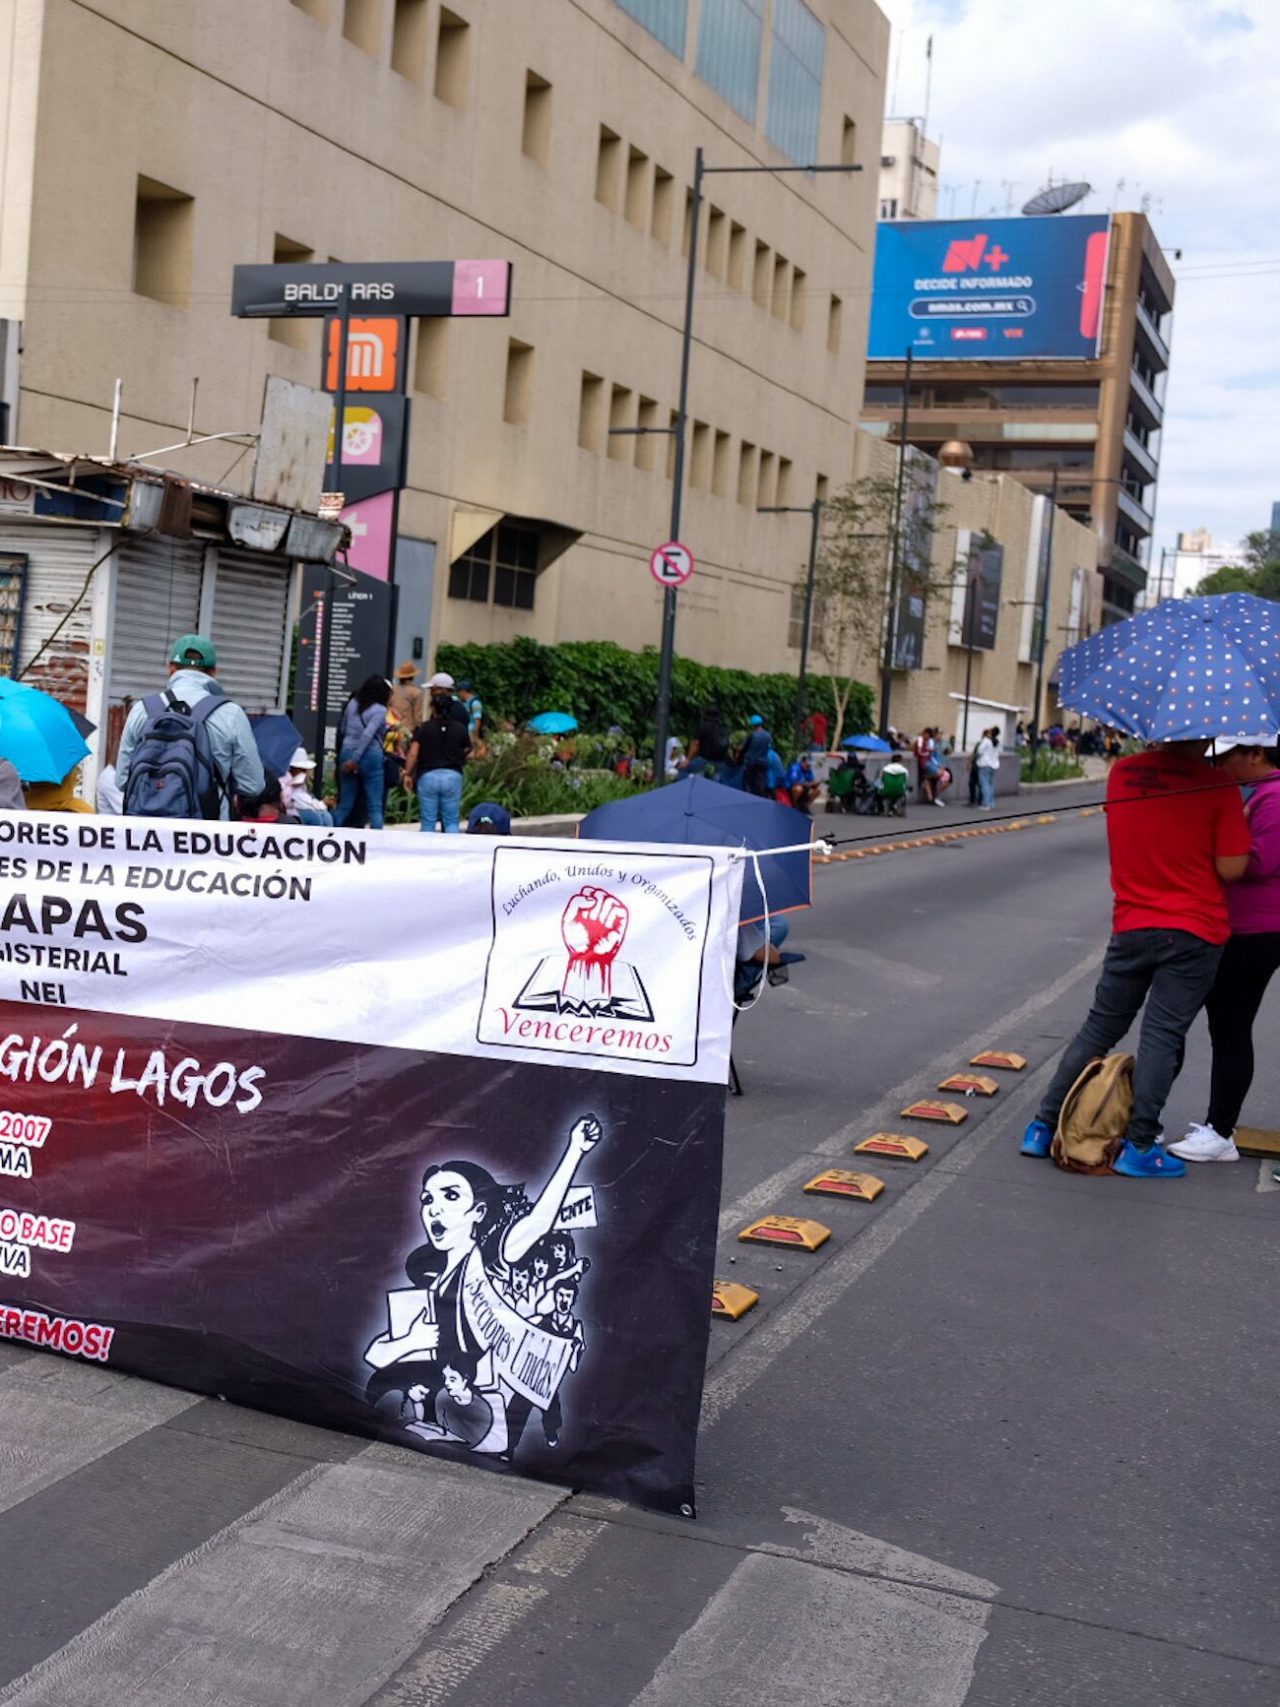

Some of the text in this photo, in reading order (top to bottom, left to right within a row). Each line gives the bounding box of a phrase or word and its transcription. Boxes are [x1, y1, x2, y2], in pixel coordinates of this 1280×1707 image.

[284, 283, 395, 300] BALDRAS
[476, 276, 484, 298] 1
[79, 827, 116, 849] DE
[125, 829, 163, 853] LA
[174, 831, 366, 864] EDUCACIÓN
[35, 859, 71, 882] DE
[80, 863, 115, 887] LA
[125, 866, 312, 901] EDUCACIÓN
[565, 863, 614, 878] Unidos
[631, 872, 696, 941] Organizados
[20, 981, 66, 1005] NEI
[495, 1007, 672, 1052] Venceremos
[110, 1048, 266, 1114] LAGOS
[0, 1116, 48, 1143] 2007
[21, 1219, 73, 1248] BASE
